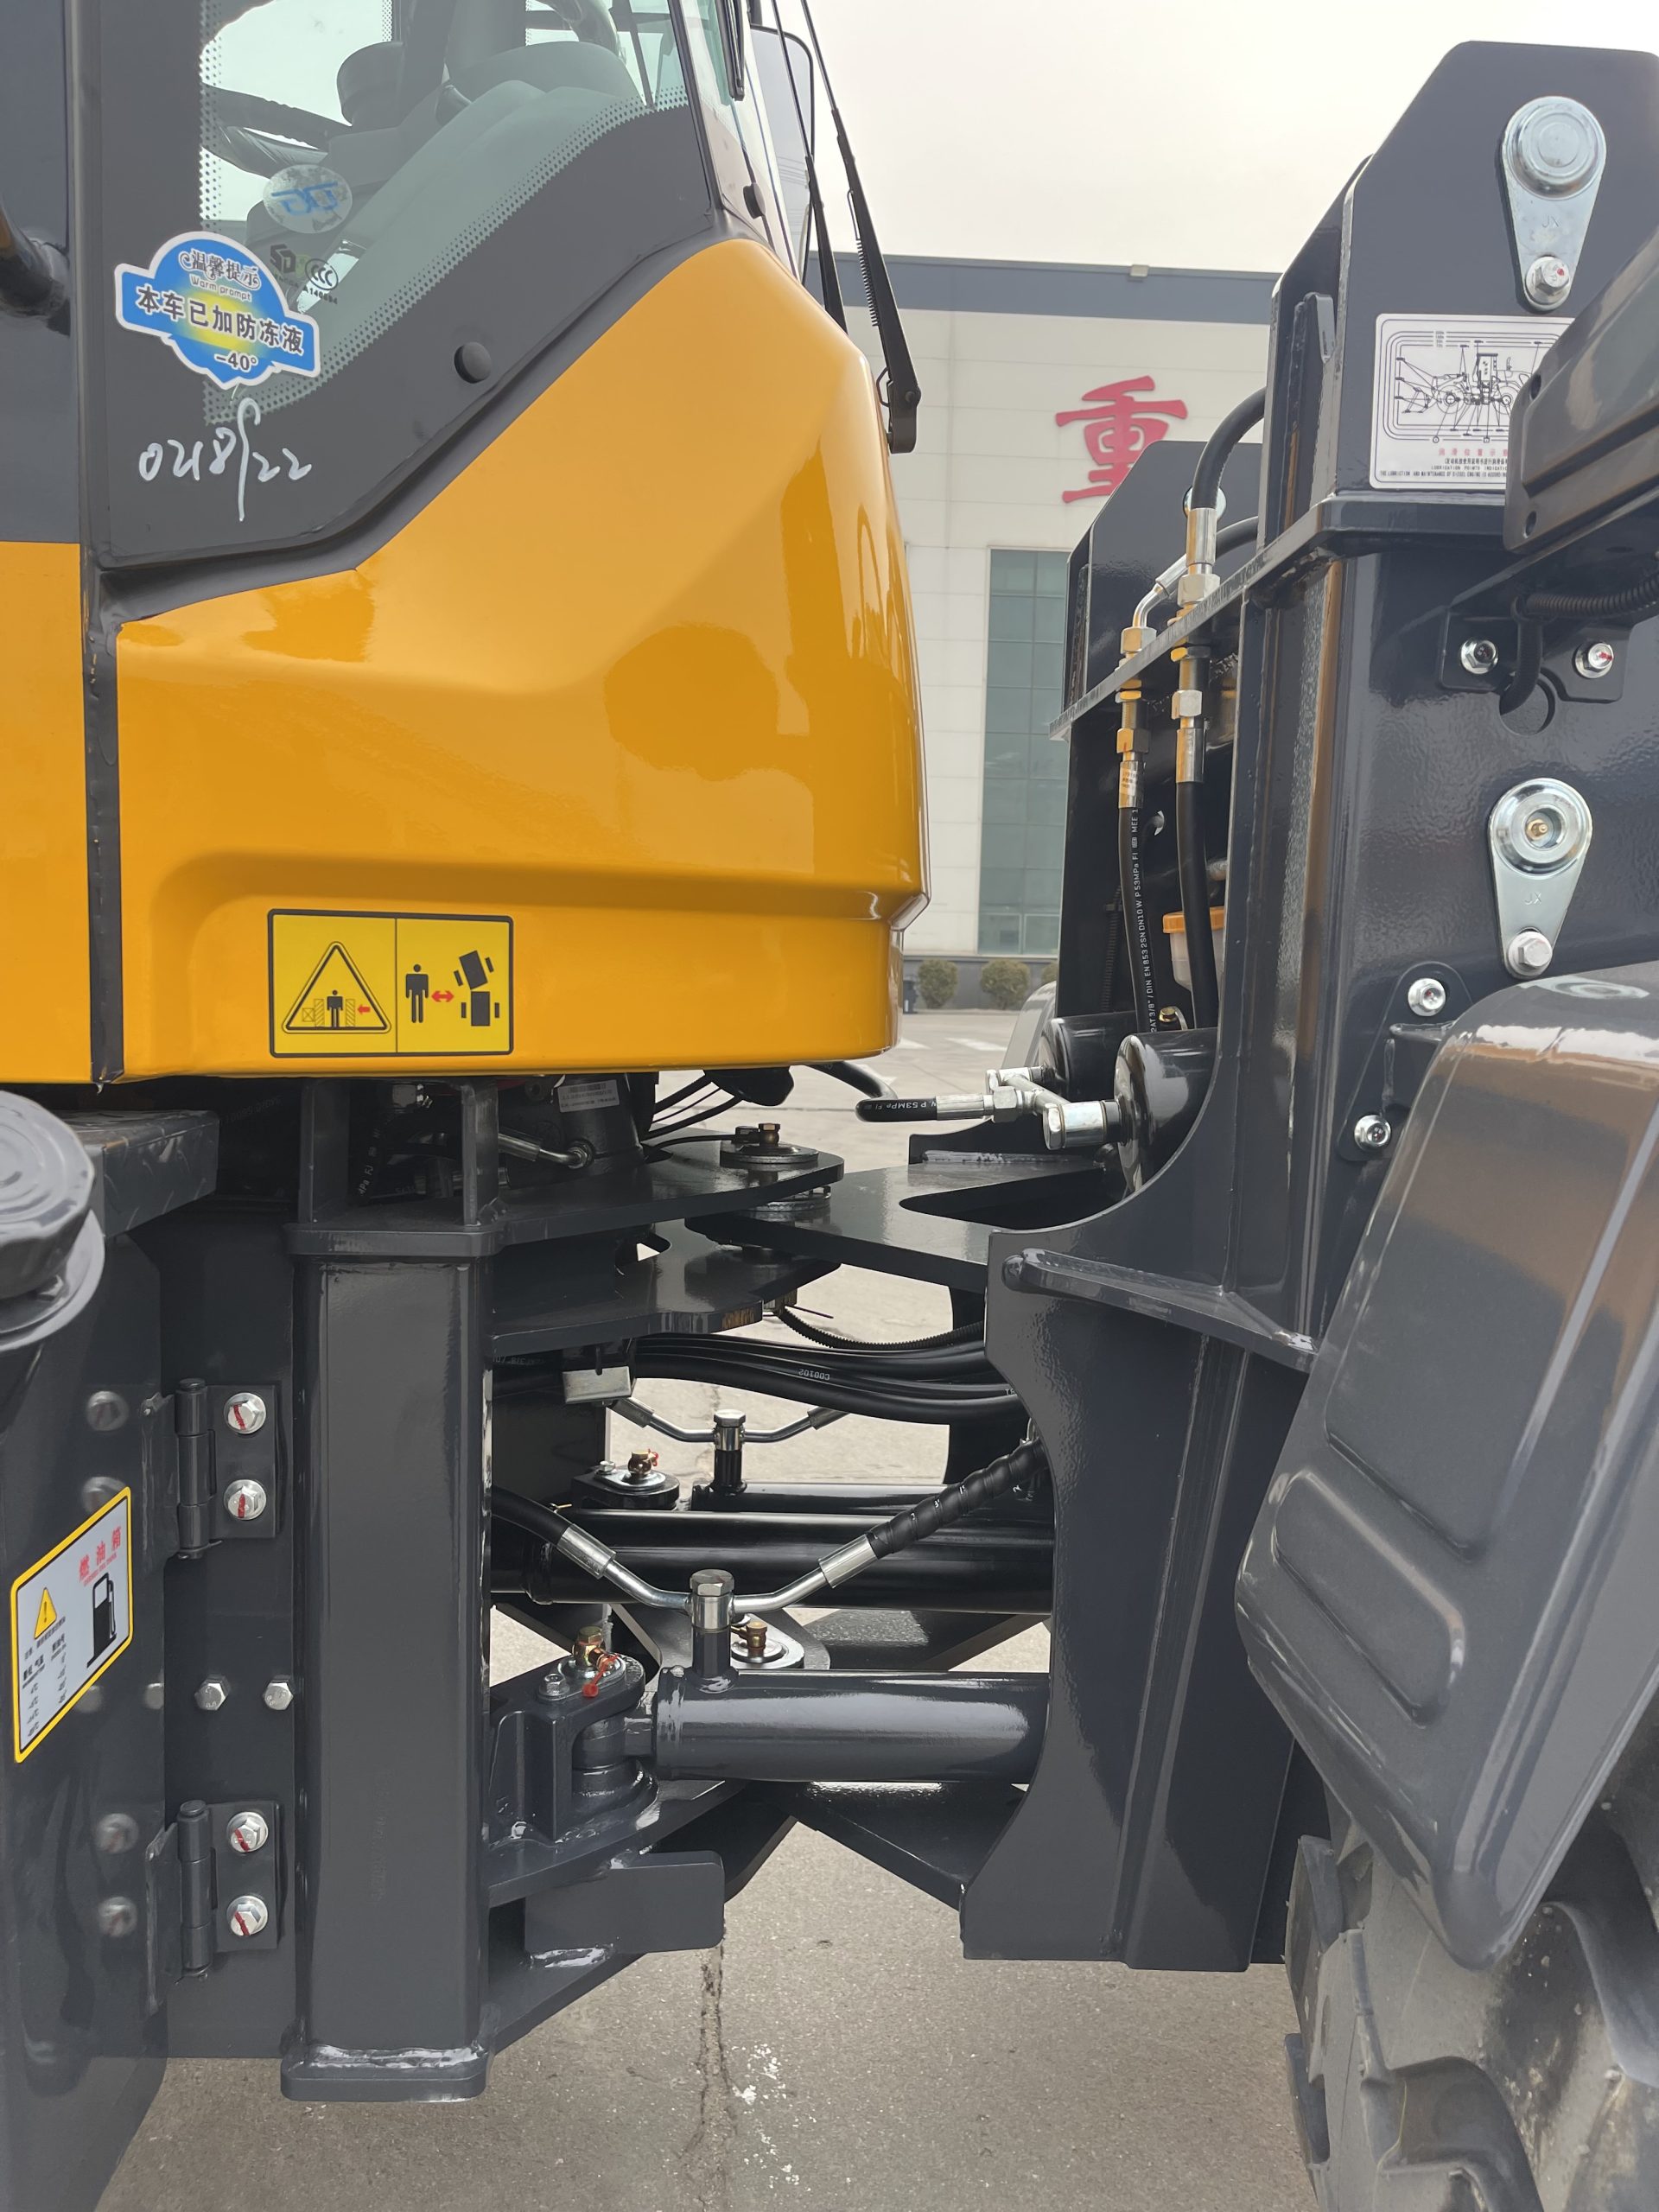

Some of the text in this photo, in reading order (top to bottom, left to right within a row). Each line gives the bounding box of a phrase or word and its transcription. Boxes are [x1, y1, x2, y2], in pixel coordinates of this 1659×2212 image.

[187, 248, 261, 290] 温馨提示
[188, 276, 253, 302] Warm prompt
[135, 285, 305, 356] 本车已加防冻液
[1055, 375, 1188, 504] 重
[798, 1369, 830, 1381] C00102
